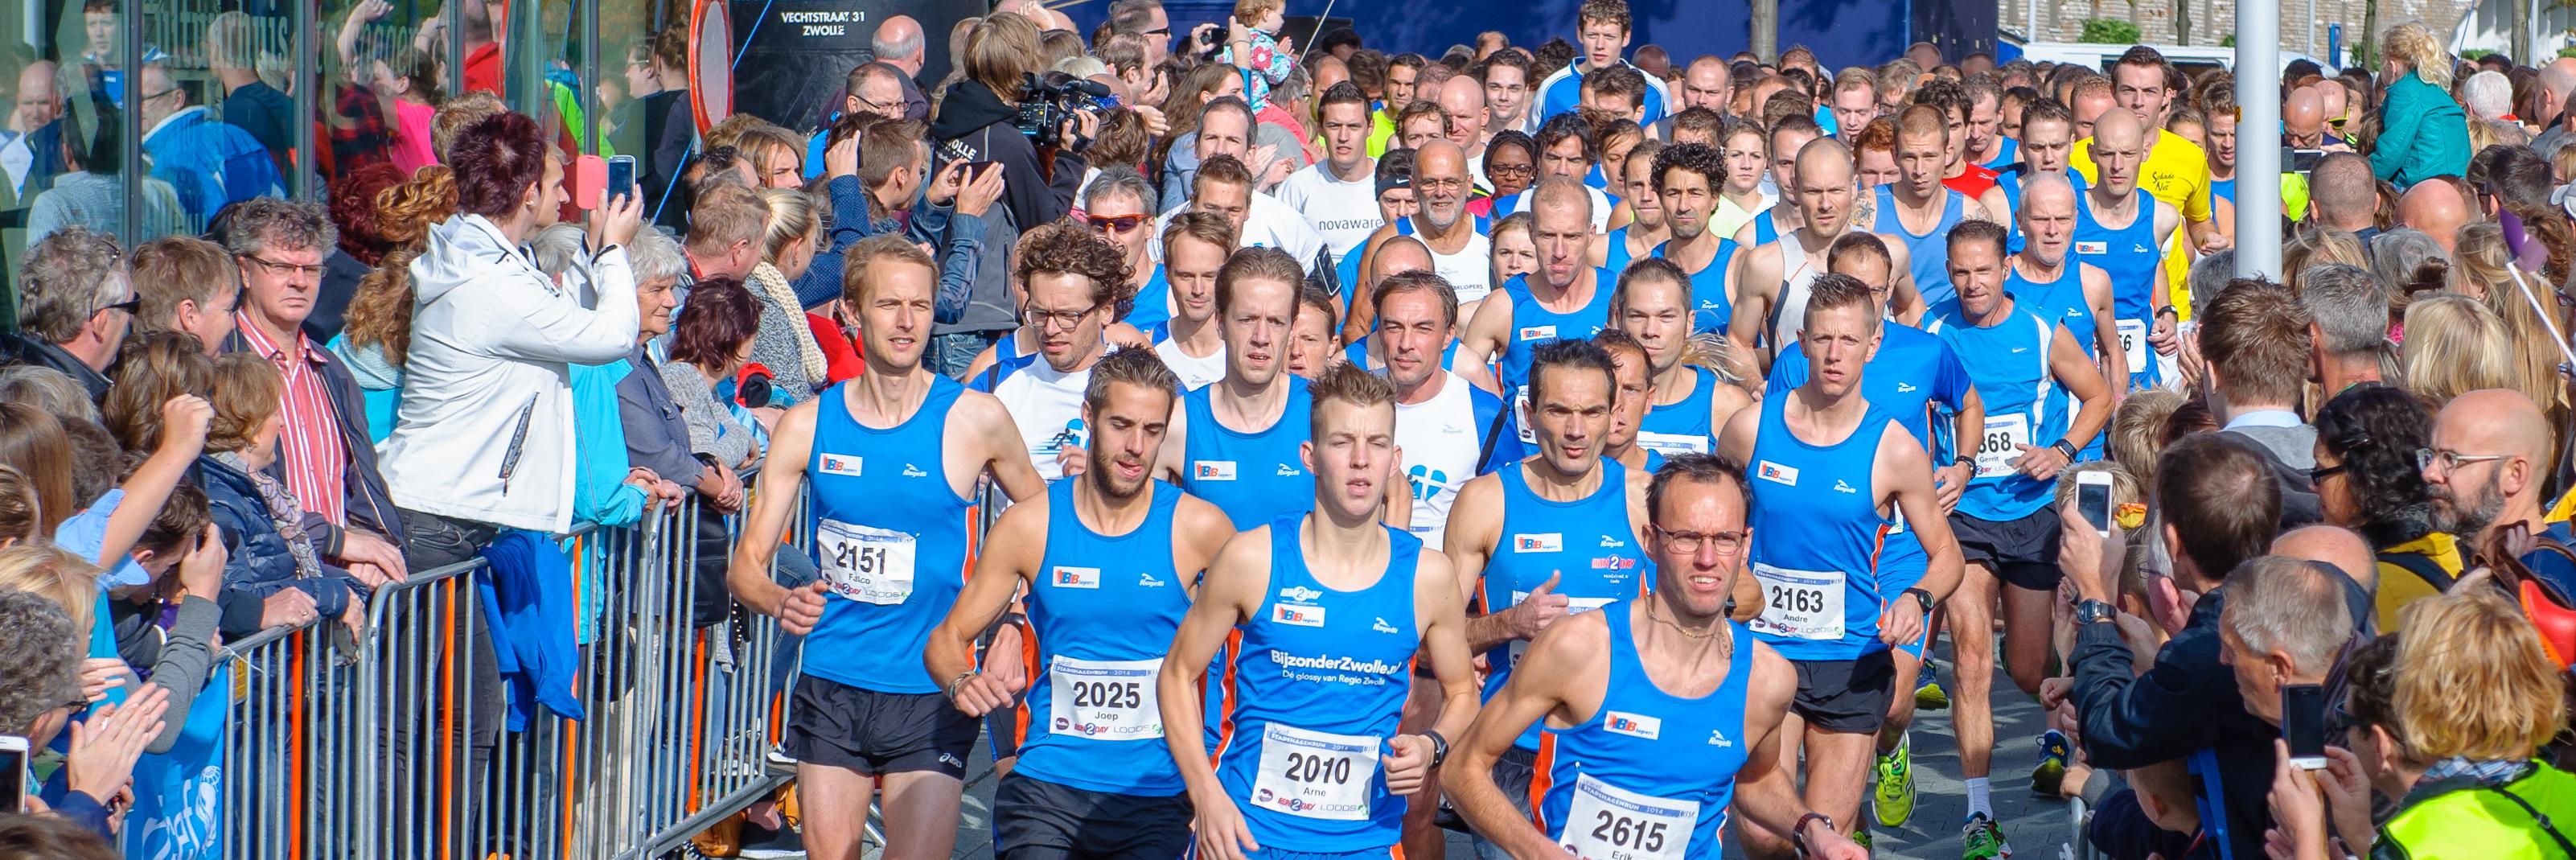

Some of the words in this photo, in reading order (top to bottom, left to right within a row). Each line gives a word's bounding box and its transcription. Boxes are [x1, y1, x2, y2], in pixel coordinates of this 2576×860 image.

[781, 11, 850, 23] VECHTSTRAAT
[853, 11, 865, 23] 31
[803, 25, 845, 36] ZWOLLE
[1319, 218, 1383, 231] novaware
[836, 541, 886, 574] 2151
[848, 573, 871, 585] Falco
[1772, 585, 1823, 613] 2163
[1784, 614, 1808, 623] Andre
[1271, 649, 1402, 675] BijzonderZwolle.nl
[1296, 672, 1322, 683] glossy
[1338, 674, 1362, 685] Regio
[1073, 681, 1140, 709] 2025
[1095, 711, 1119, 722] Joep
[1285, 752, 1350, 785] 2010
[1303, 787, 1326, 797] Arne
[1582, 785, 1640, 811] STADSHAGENRUN
[1645, 807, 1664, 815] 2014
[1320, 803, 1358, 812] LOODS
[1591, 809, 1668, 853] 2615
[1612, 850, 1633, 860] Erik
